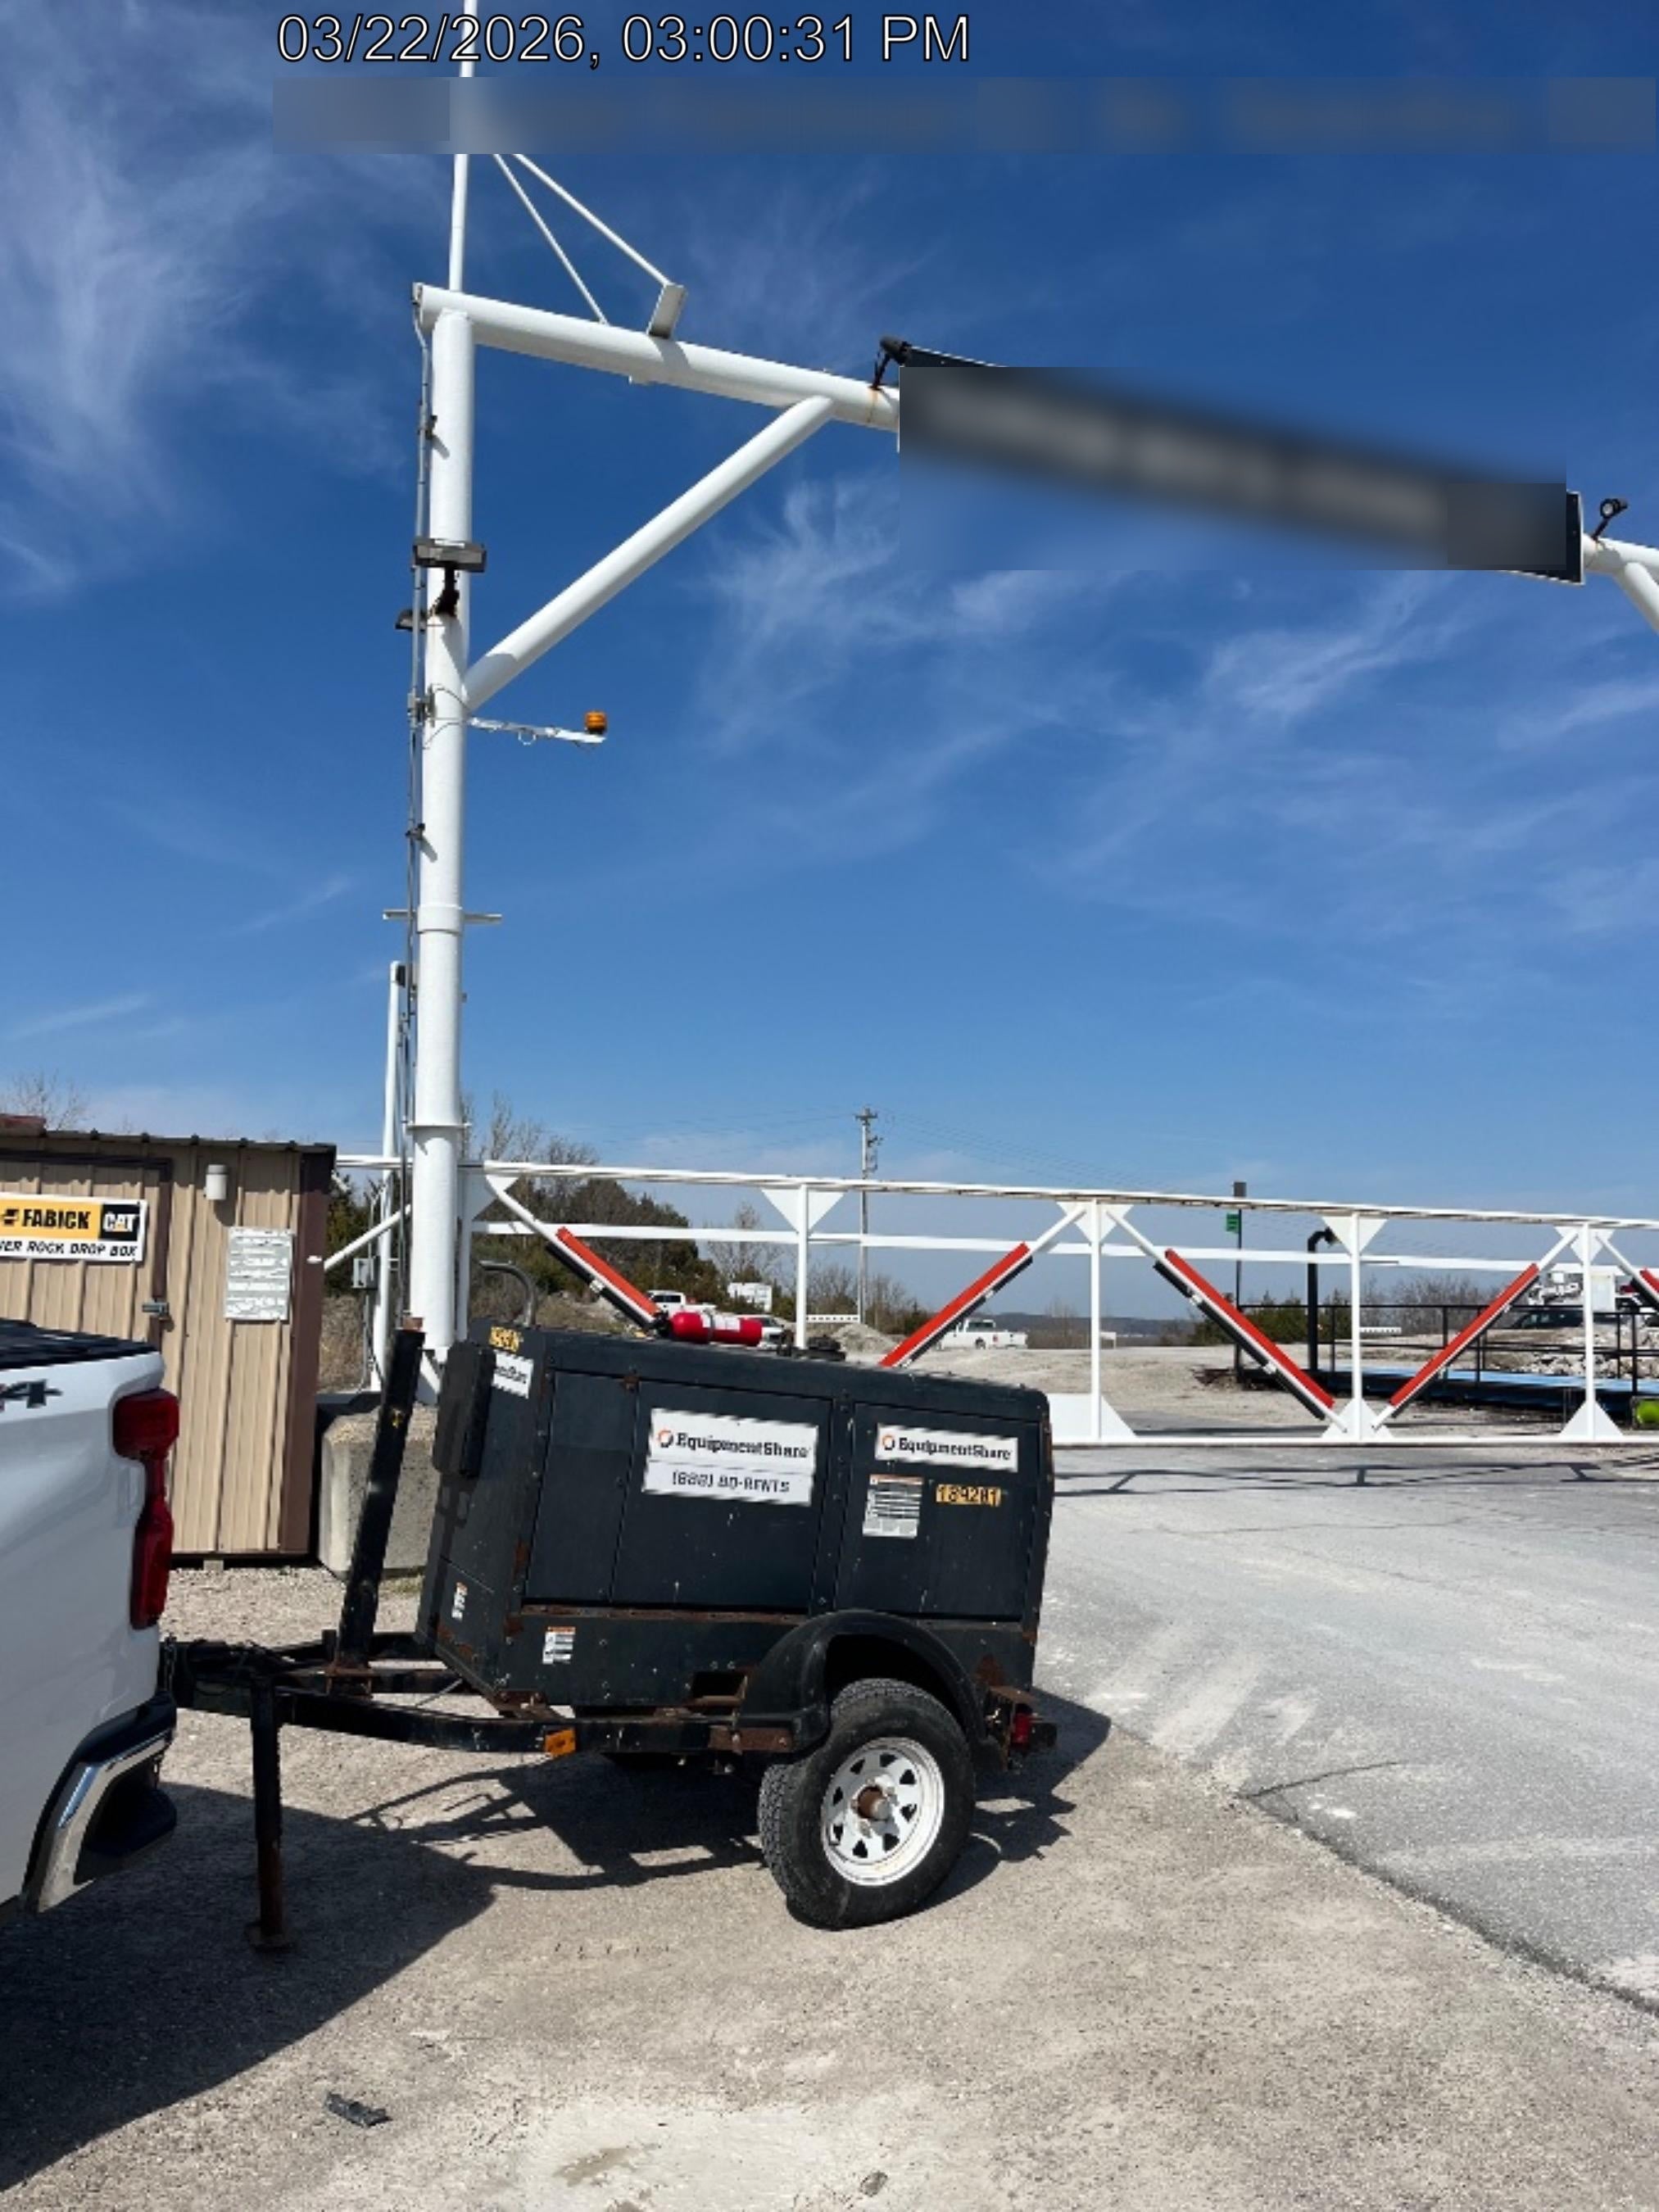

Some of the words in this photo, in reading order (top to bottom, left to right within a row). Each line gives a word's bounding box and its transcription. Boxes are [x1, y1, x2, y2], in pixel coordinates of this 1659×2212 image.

[22, 1208, 91, 1230] FABICK
[103, 1212, 139, 1232] CAT
[27, 1240, 65, 1255] ROCK
[70, 1242, 107, 1256] DROP
[110, 1244, 138, 1258] BOX
[0, 1378, 64, 1411] 4
[676, 1431, 809, 1459] EquipmentShare
[899, 1437, 1013, 1461] EquipmentShare
